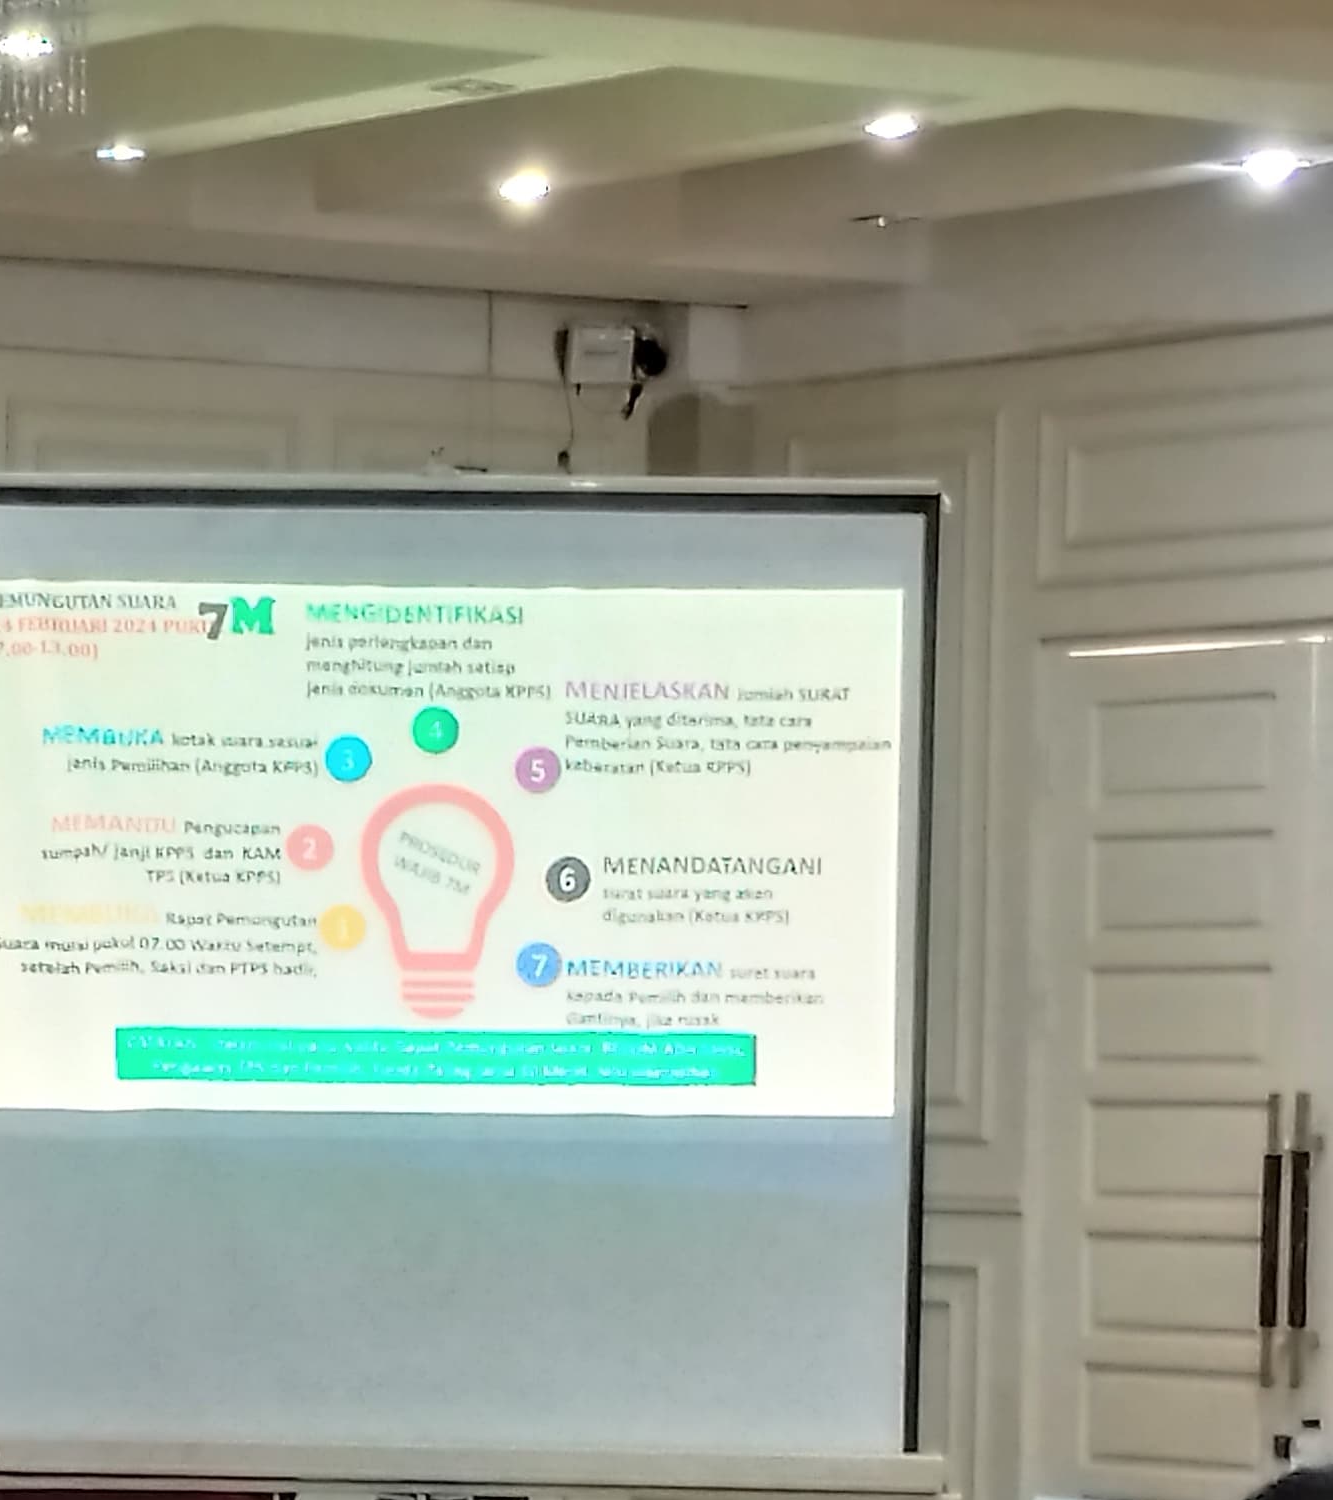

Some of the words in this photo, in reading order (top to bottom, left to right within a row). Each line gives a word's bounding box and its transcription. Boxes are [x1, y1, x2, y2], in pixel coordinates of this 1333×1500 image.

[116, 593, 178, 610] SUARA
[305, 602, 524, 625] MENGIDENTIFIKASI
[462, 635, 493, 650] dan
[564, 681, 730, 701] MENJELASKAN
[42, 727, 164, 746] MEMBUKA
[530, 759, 546, 783] 5
[203, 845, 235, 861] dan
[301, 837, 318, 861] 2
[602, 856, 823, 876] MENANDATANGANI
[558, 866, 576, 892] 6
[531, 953, 549, 978] 7
[565, 959, 723, 980] MEMBERIKAN
